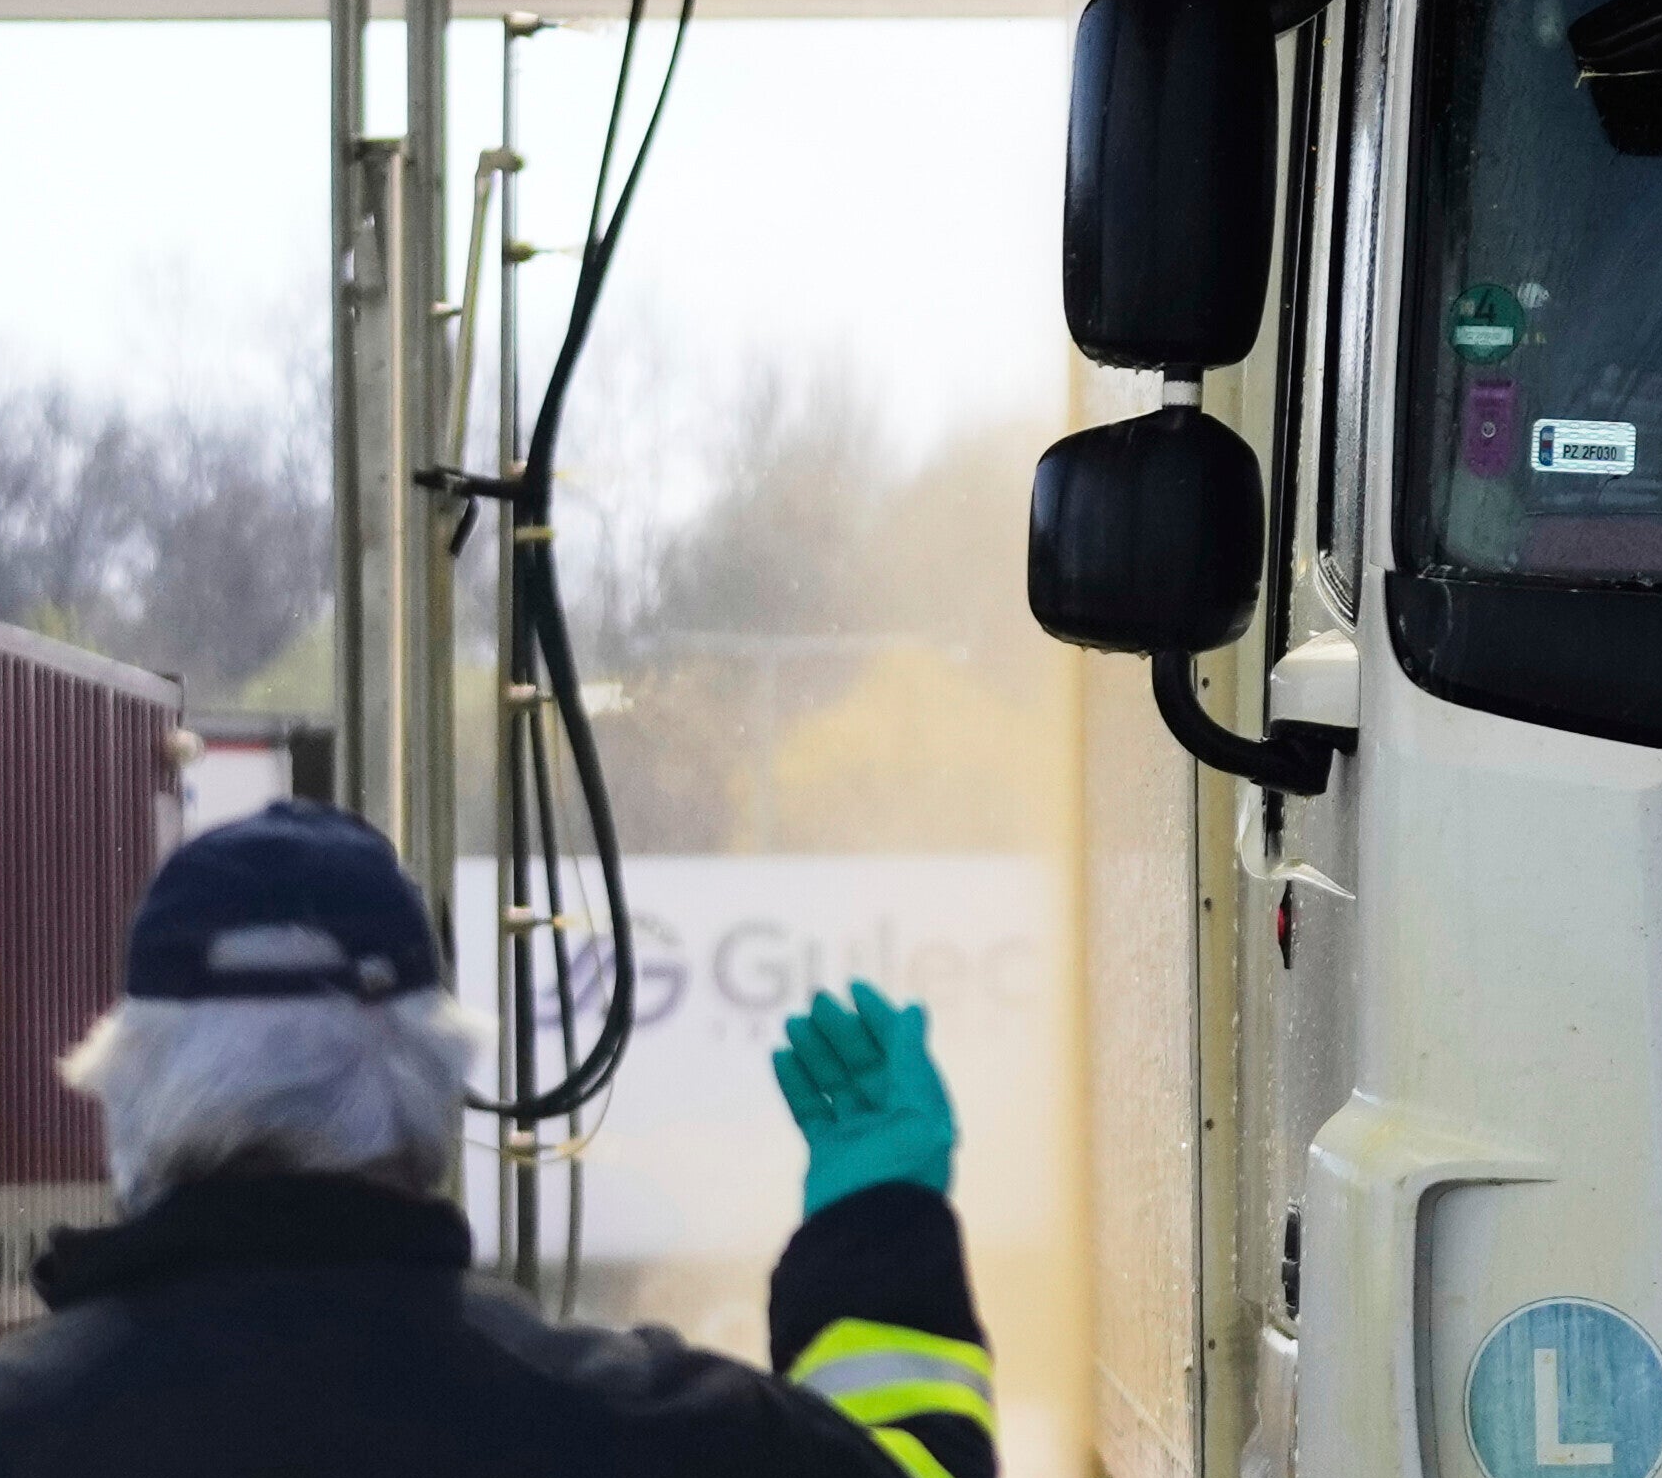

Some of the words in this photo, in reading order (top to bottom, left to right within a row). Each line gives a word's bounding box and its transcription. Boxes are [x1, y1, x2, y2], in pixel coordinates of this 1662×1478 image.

[1474, 288, 1497, 324] 4
[1562, 444, 1579, 459] PZ
[1582, 445, 1618, 461] 2F030
[1534, 1348, 1614, 1465] L
